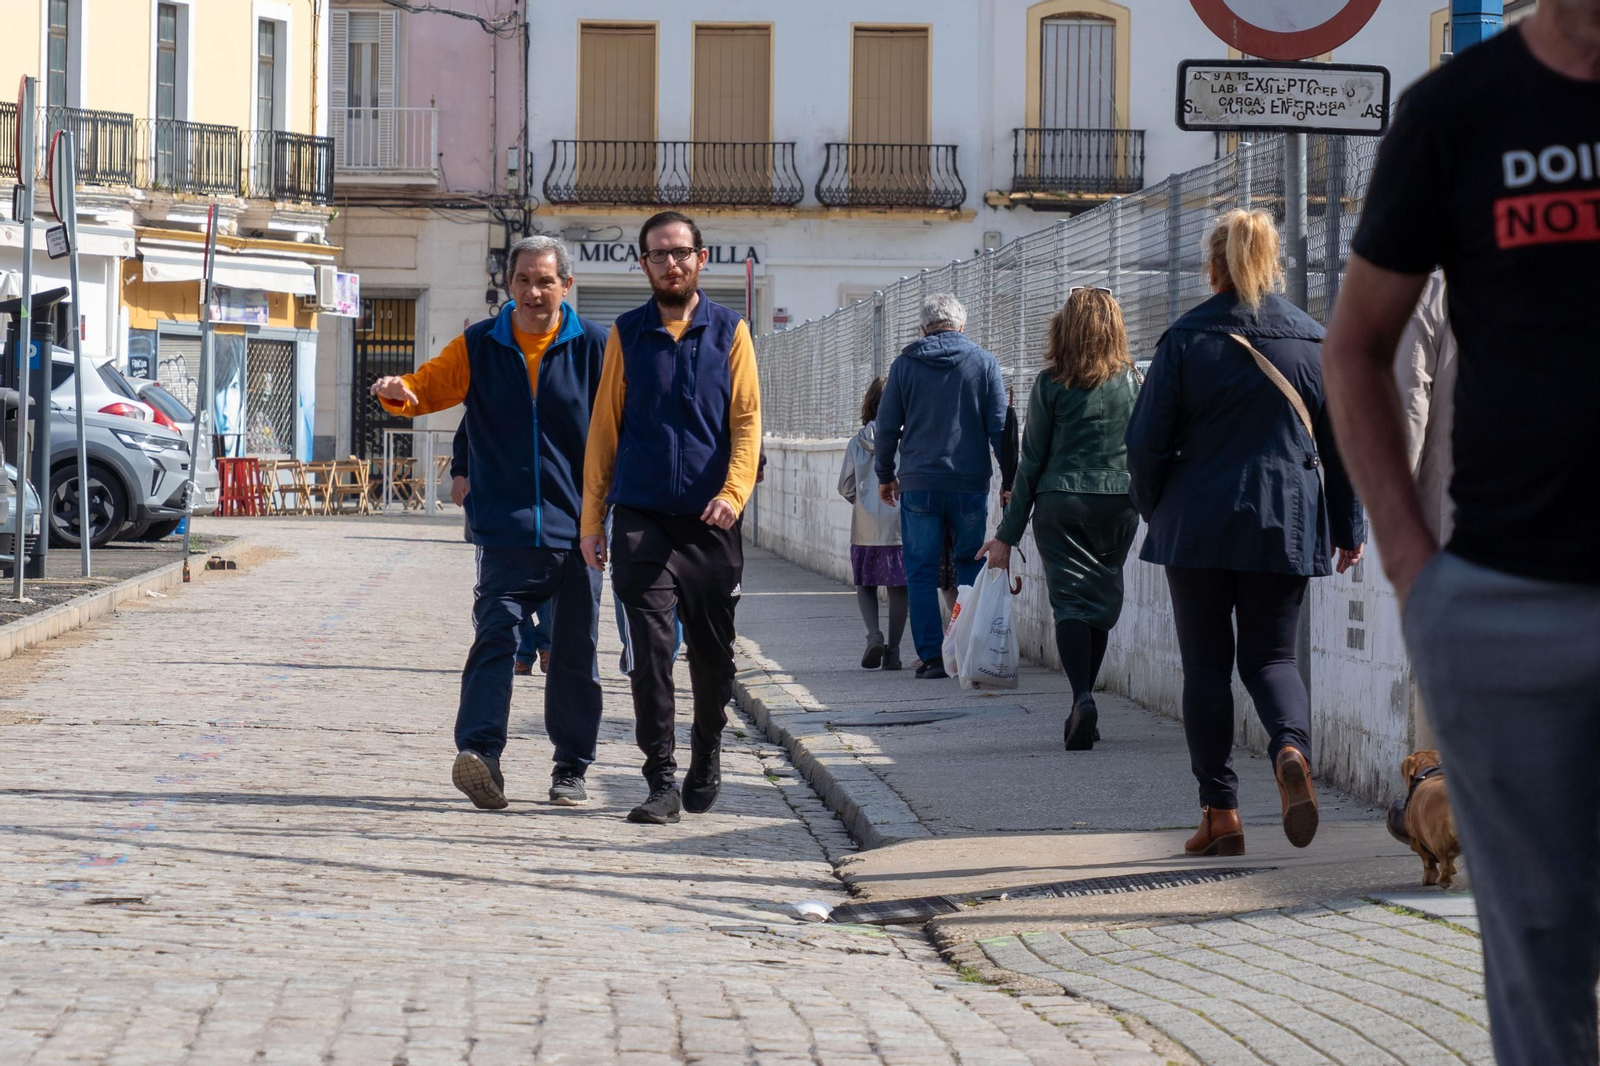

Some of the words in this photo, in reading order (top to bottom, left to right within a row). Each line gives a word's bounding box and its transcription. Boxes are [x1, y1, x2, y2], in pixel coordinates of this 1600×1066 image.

[1224, 72, 1232, 80] A
[1236, 72, 1249, 80] 13
[579, 243, 639, 262] MICA
[707, 245, 760, 264] ILLA
